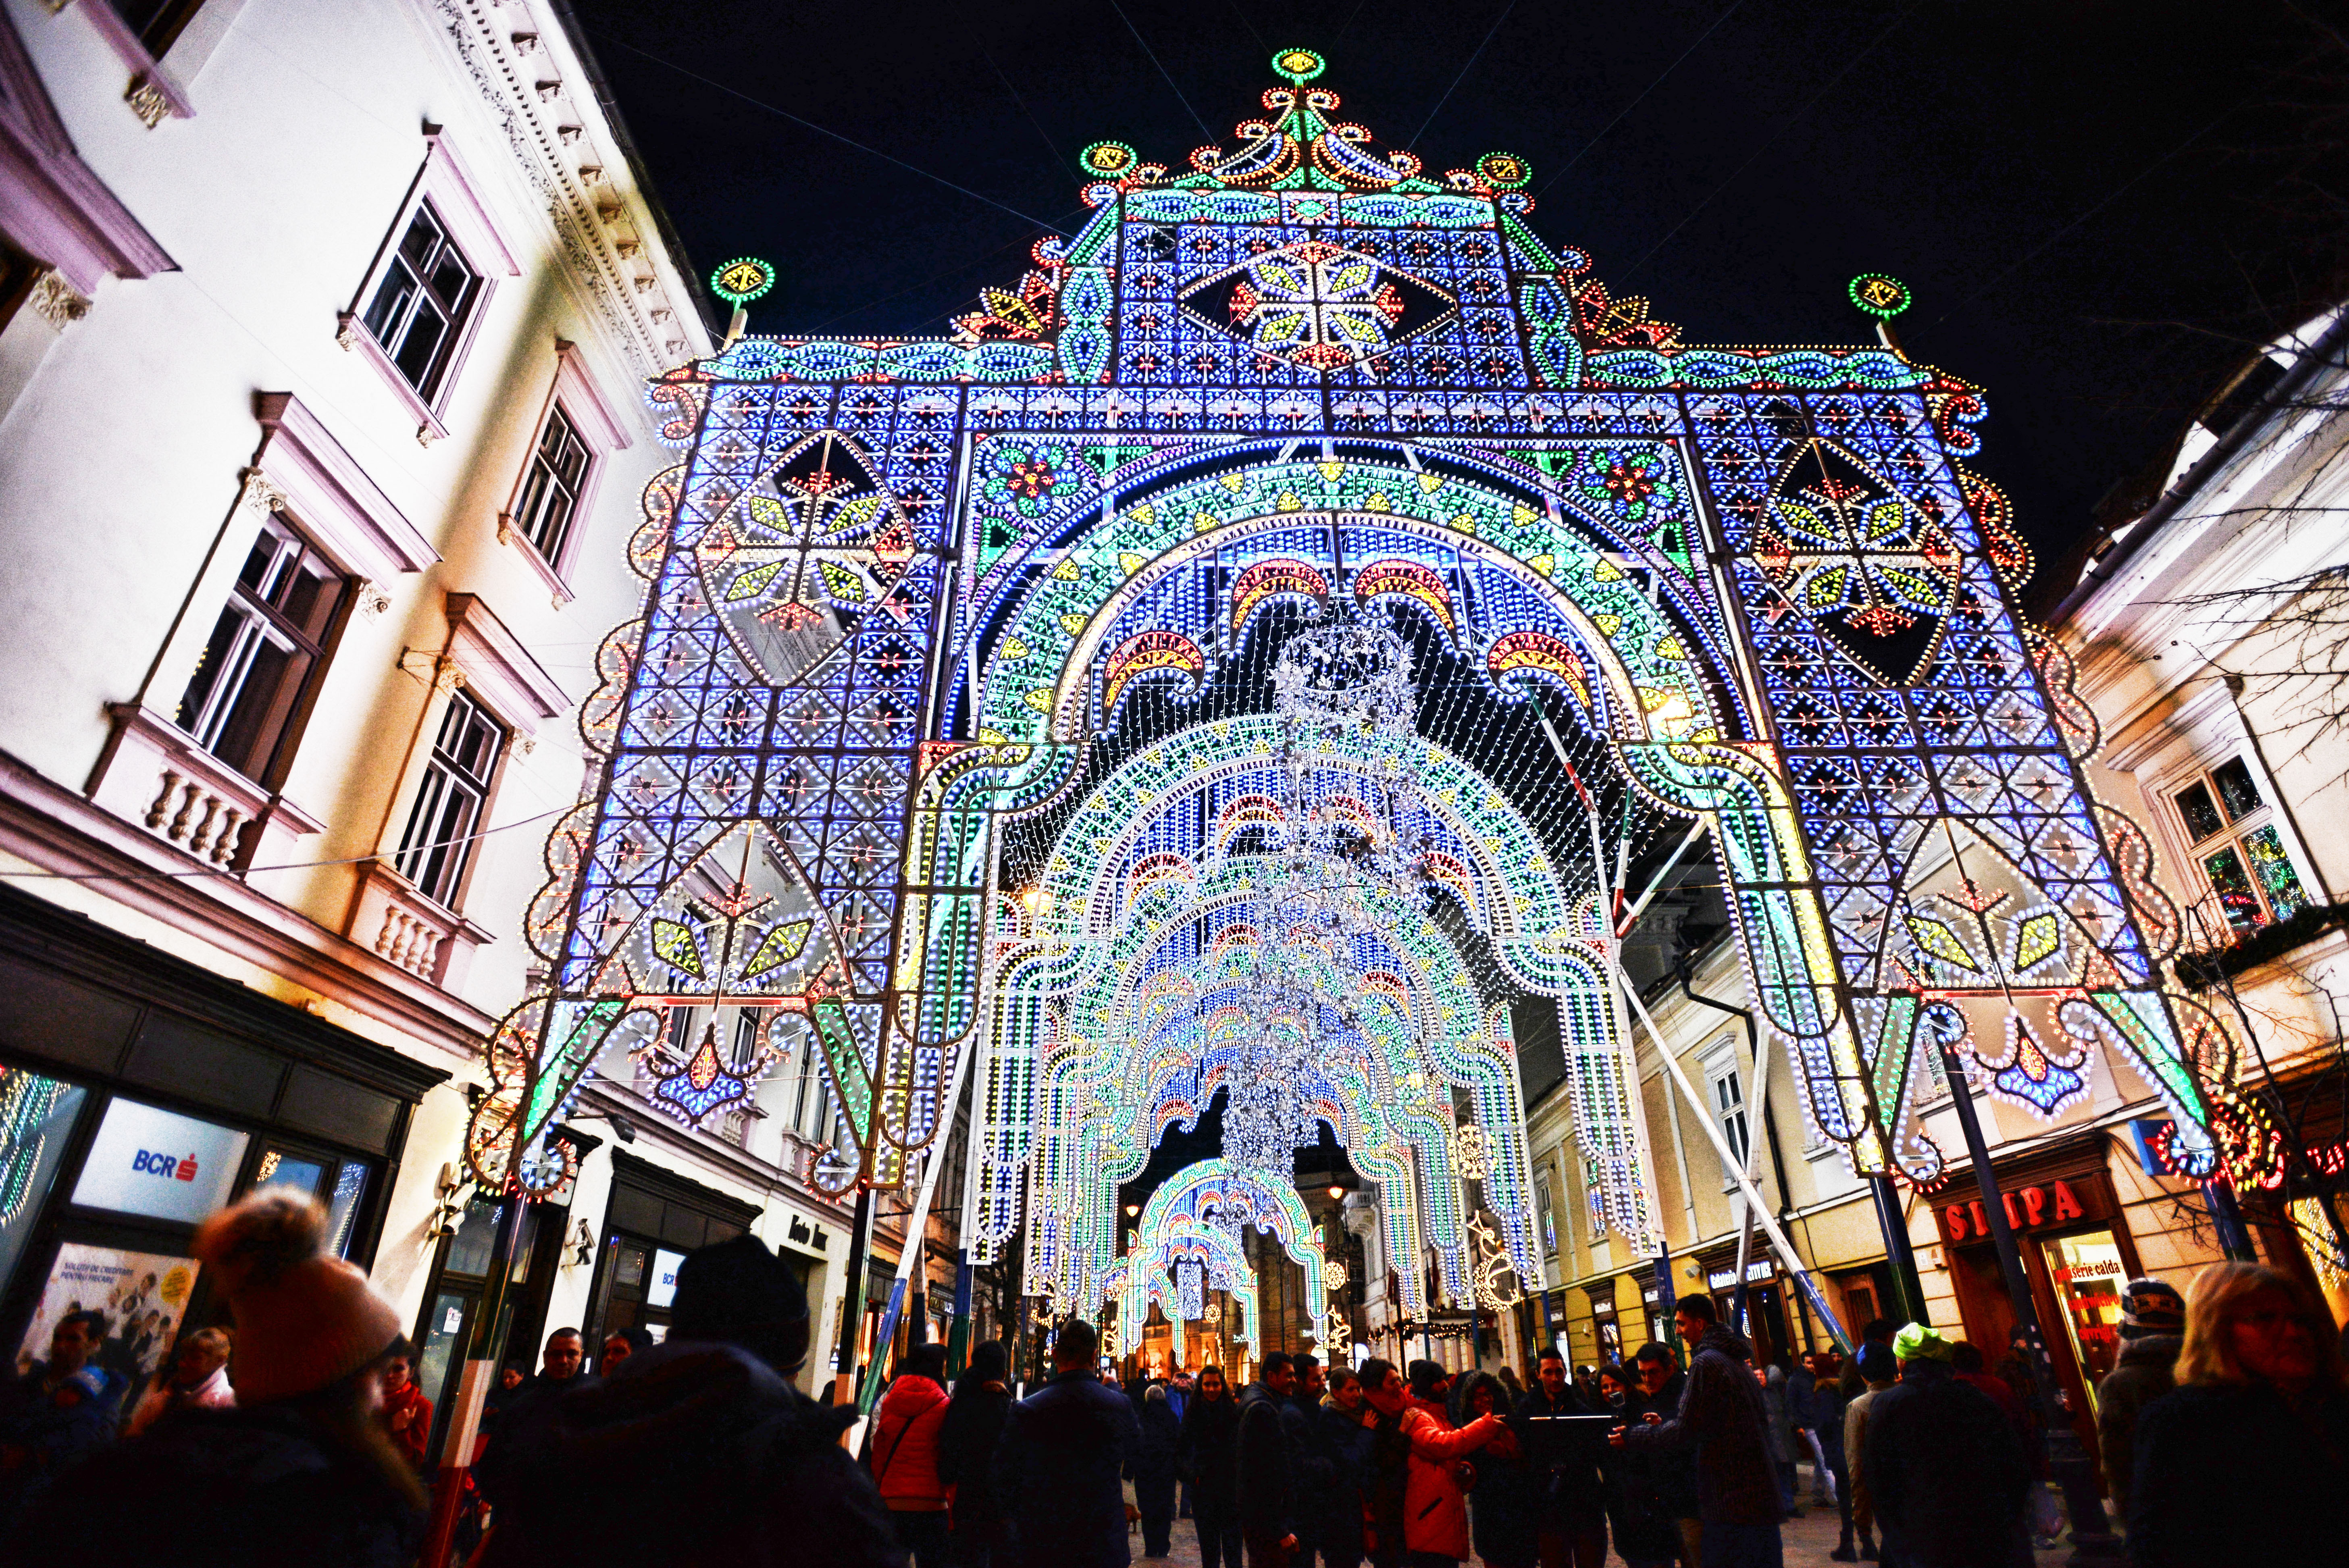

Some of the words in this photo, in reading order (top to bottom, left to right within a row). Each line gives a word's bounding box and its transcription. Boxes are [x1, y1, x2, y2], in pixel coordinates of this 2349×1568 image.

[132, 1149, 177, 1177] BCR
[788, 1214, 810, 1244] Foto
[1760, 1262, 1773, 1278] ICE
[2095, 1259, 2120, 1275] calda
[662, 1273, 674, 1285] BCR
